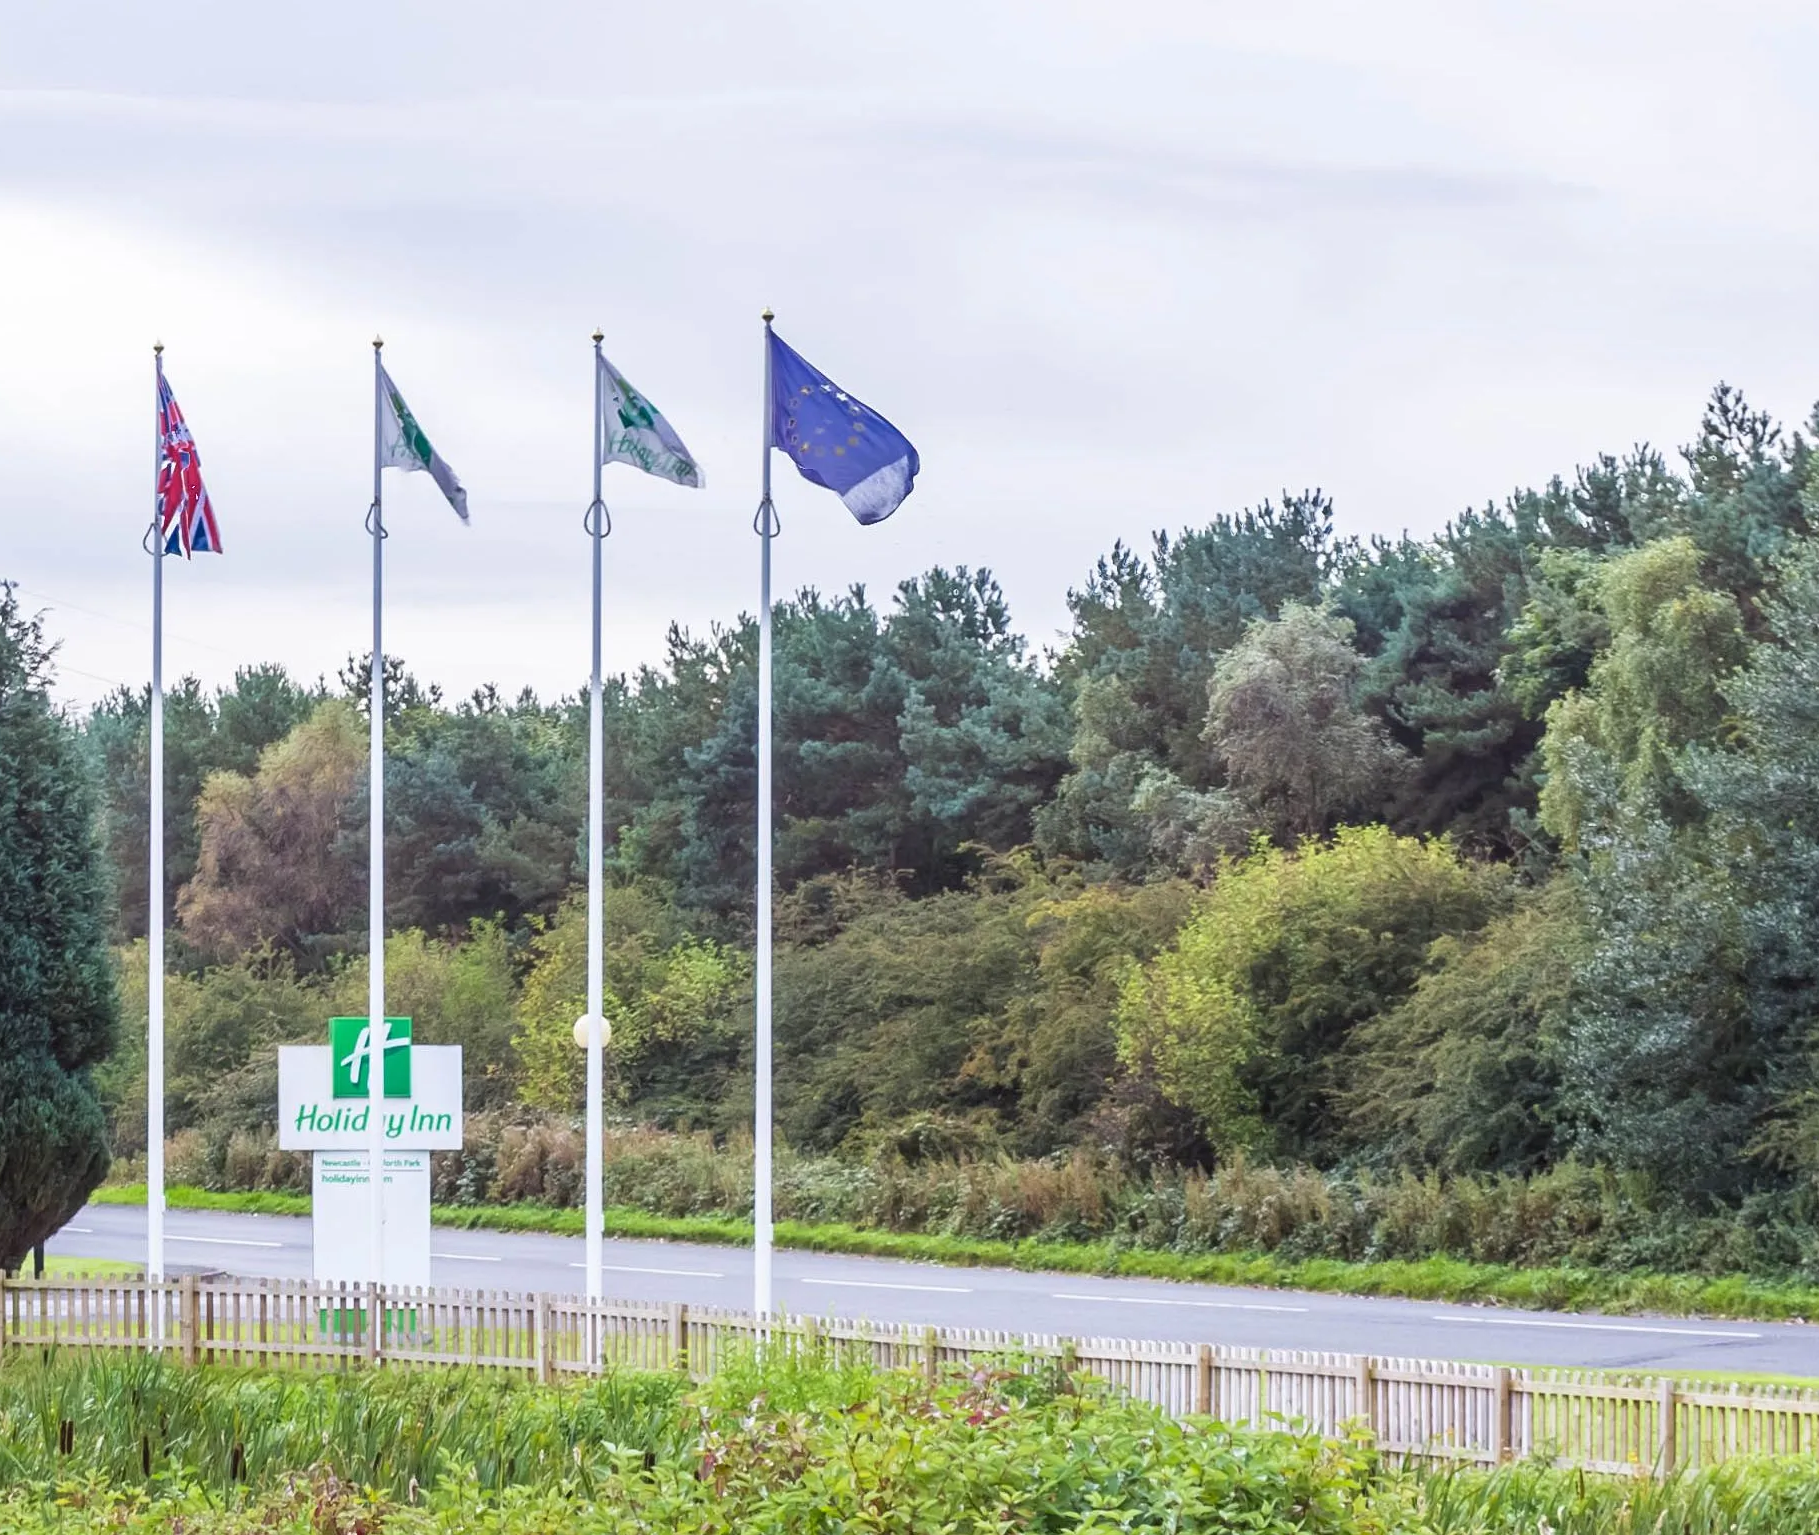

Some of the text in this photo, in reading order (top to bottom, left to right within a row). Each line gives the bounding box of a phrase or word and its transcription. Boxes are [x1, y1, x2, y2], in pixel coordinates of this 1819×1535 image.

[295, 1104, 452, 1138] Holidy Inn
[321, 1174, 393, 1185] holidayinnm
